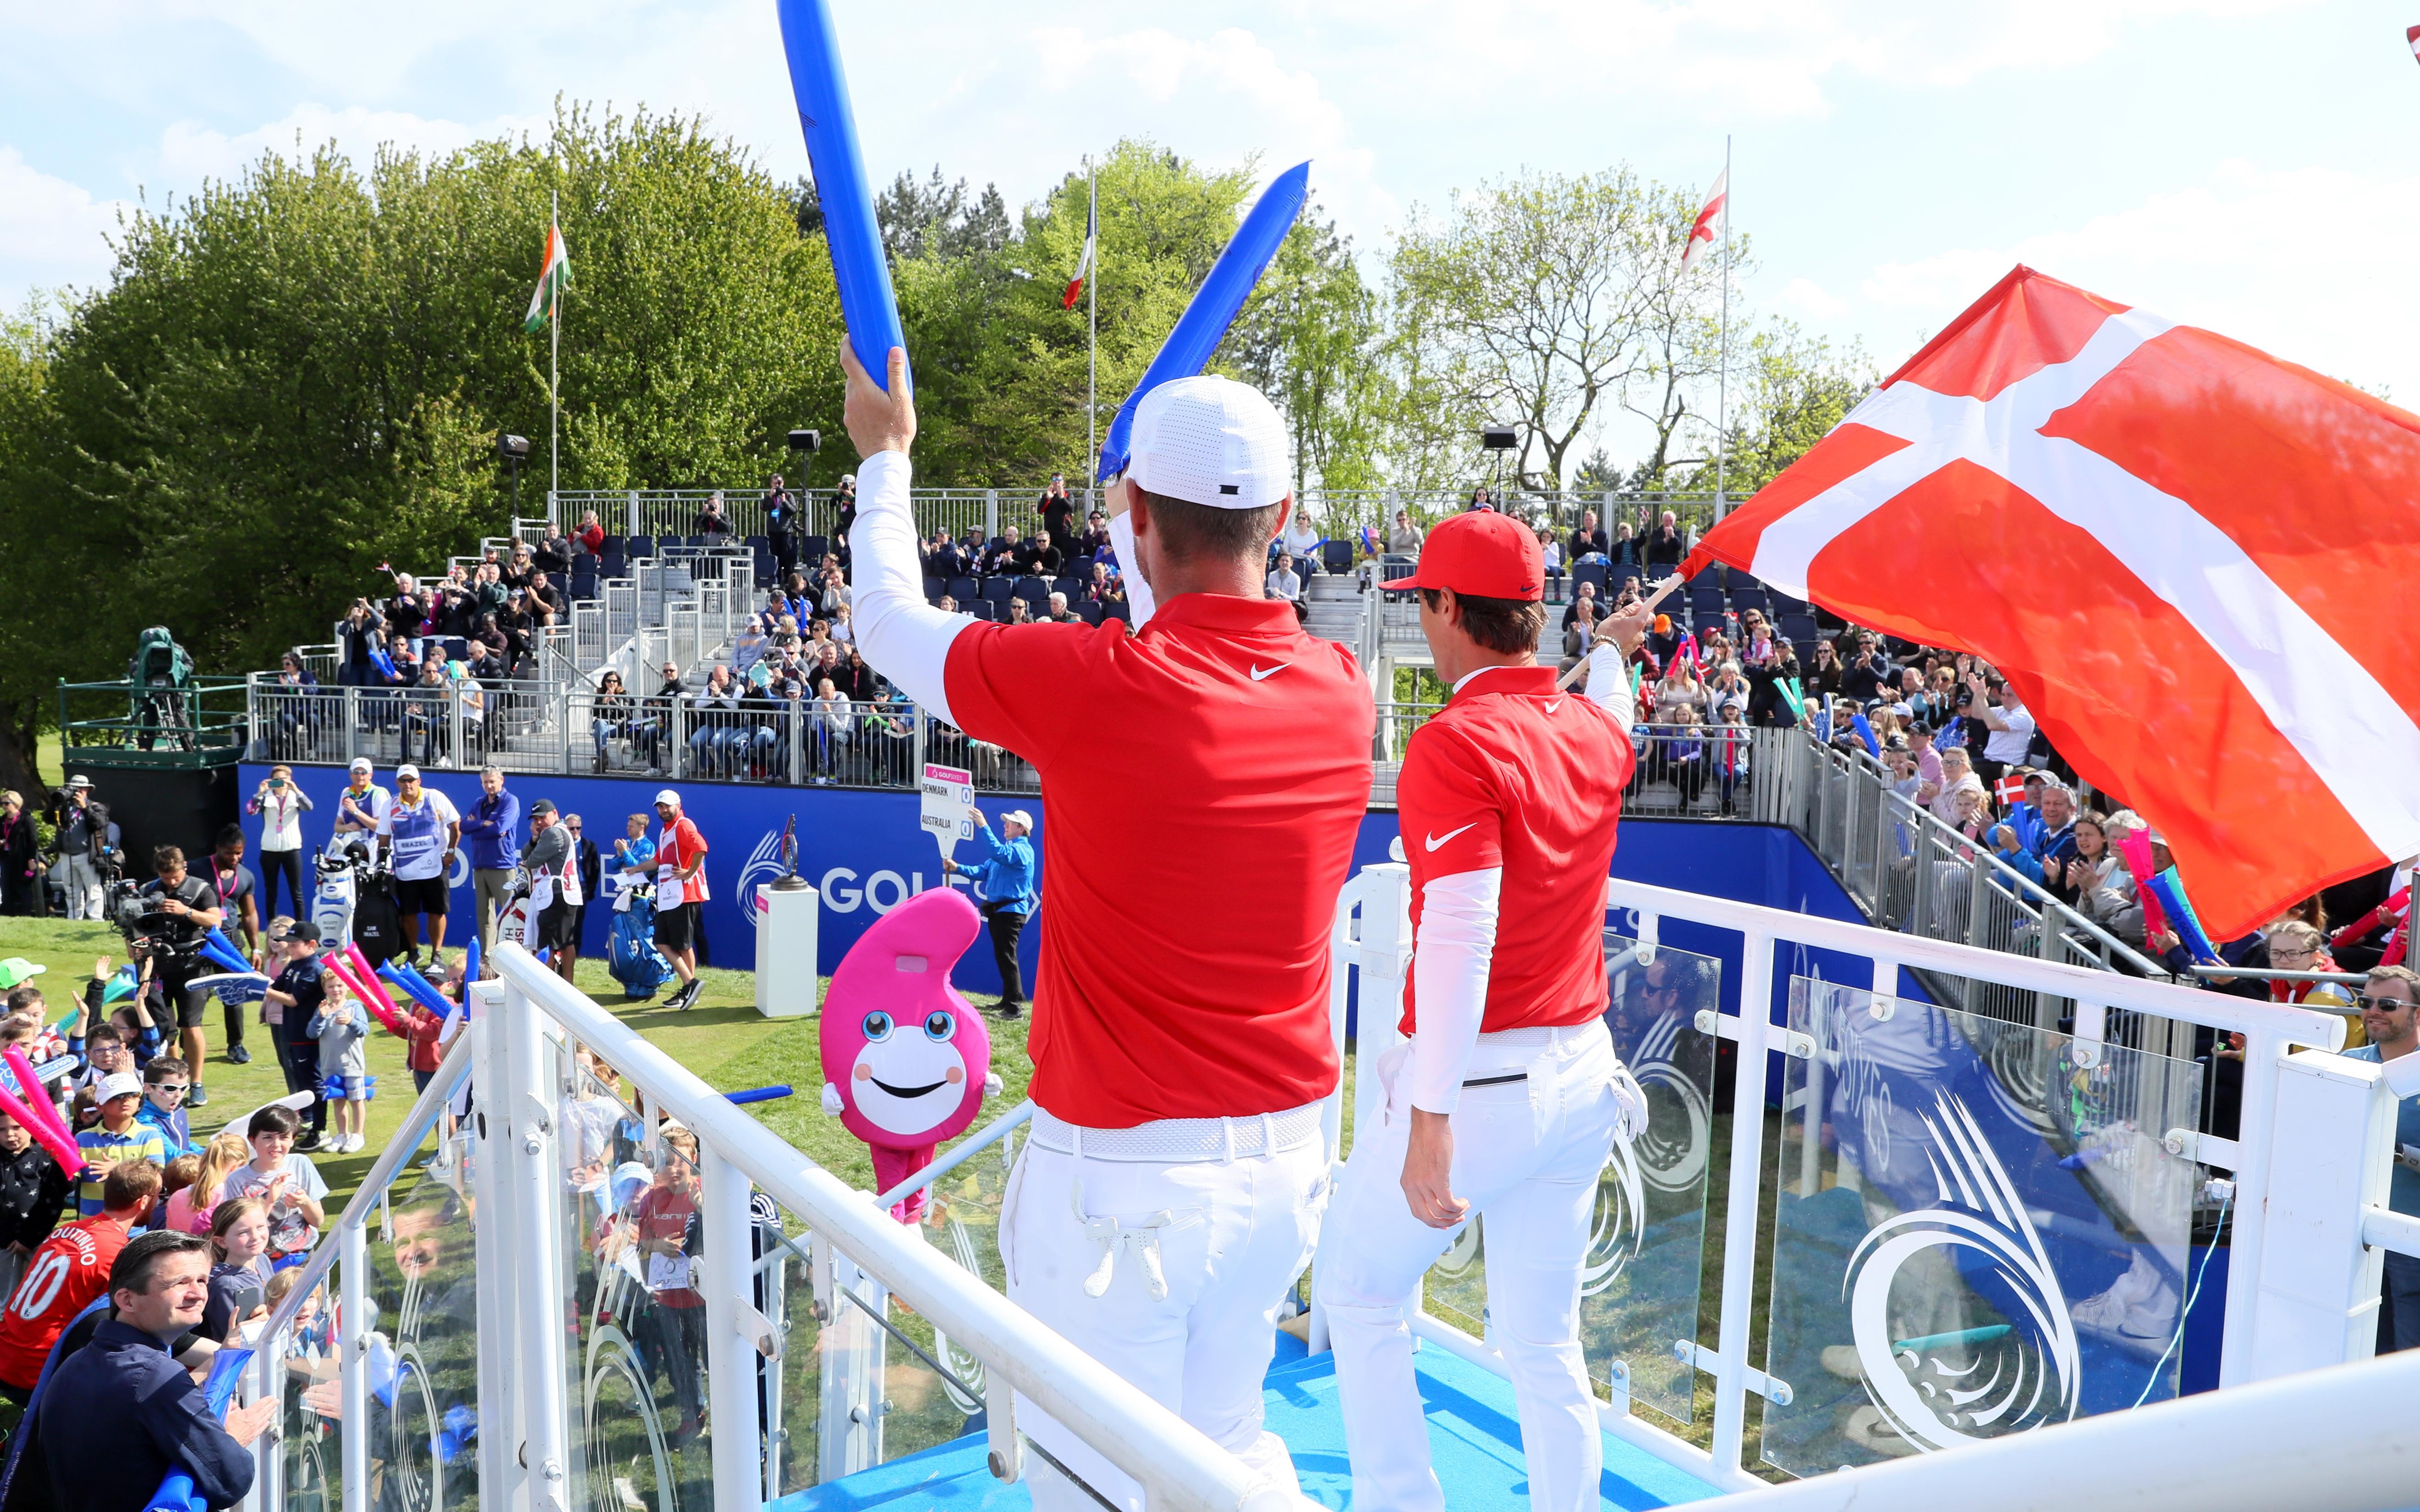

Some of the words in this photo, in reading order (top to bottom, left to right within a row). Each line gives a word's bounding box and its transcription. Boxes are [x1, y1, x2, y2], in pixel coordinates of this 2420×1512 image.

[939, 771, 962, 781] GOLFSIXES
[922, 783, 948, 797] DENMARK
[963, 788, 970, 803] 0
[921, 814, 951, 829] AUSTRALIA
[962, 822, 970, 836] 0
[9, 1249, 71, 1321] 10
[6, 1451, 21, 1485] EUROPEAN
[1, 1485, 9, 1503] TOUR
